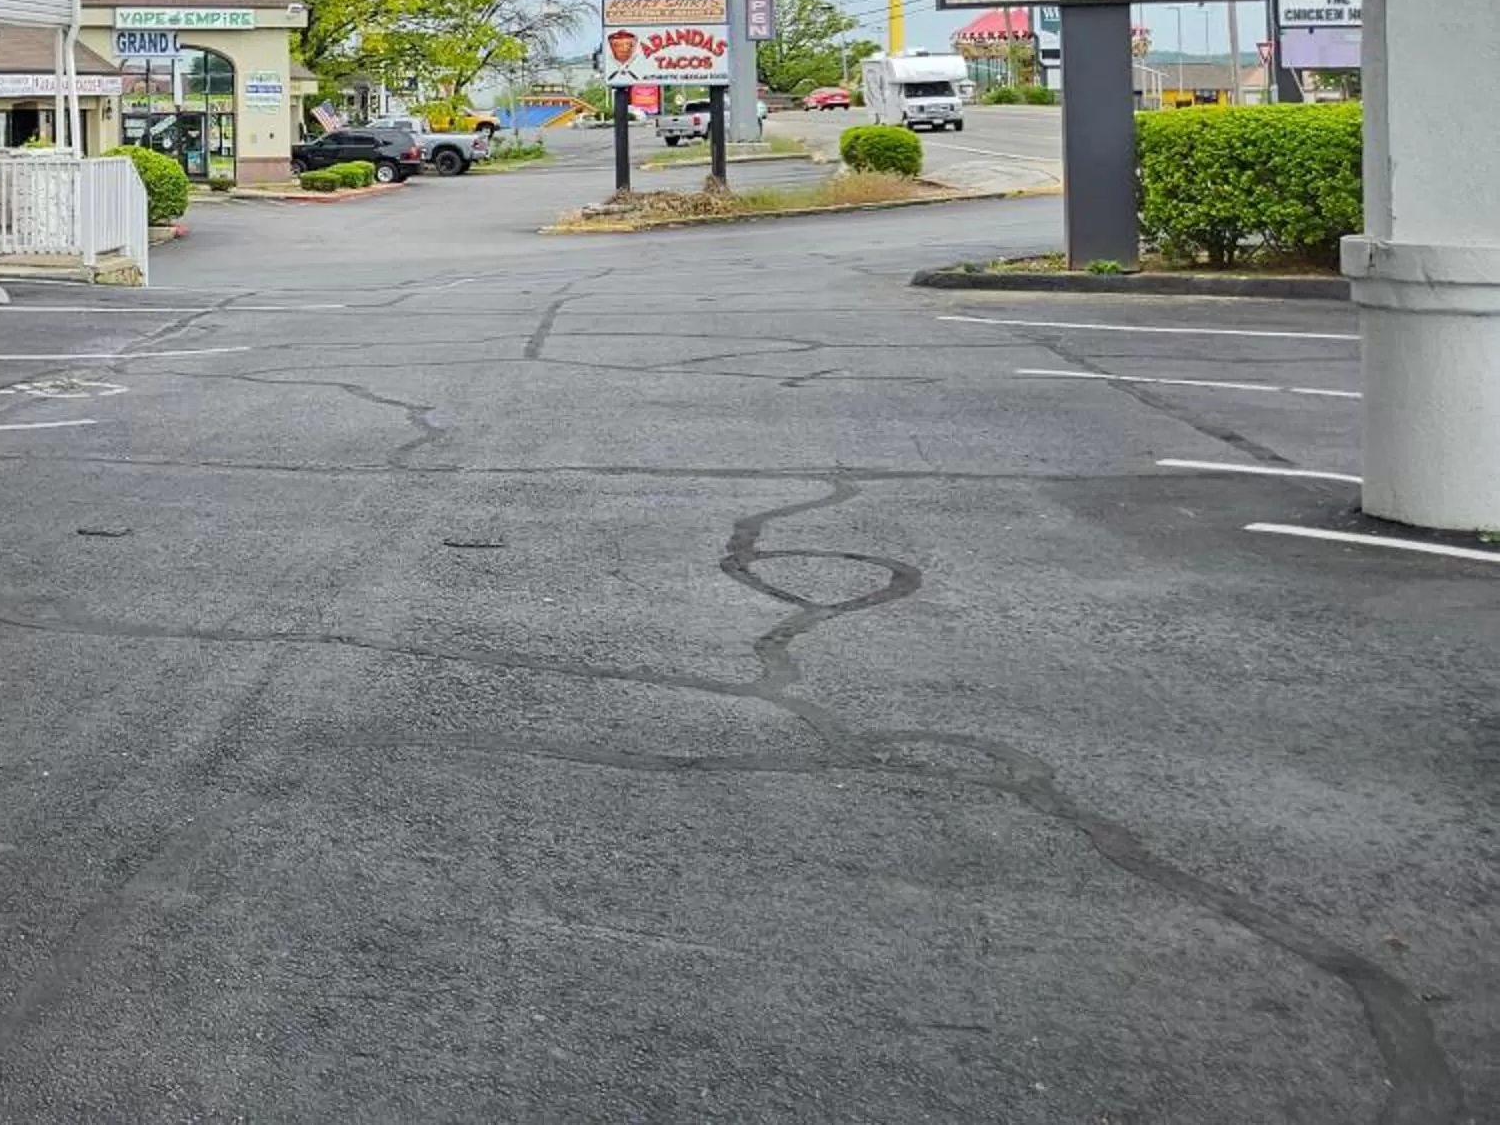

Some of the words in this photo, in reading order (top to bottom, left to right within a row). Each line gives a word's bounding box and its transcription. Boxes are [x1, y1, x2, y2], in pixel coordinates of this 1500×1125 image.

[120, 12, 165, 25] VAPE
[1284, 8, 1344, 21] CHICKEN
[117, 32, 169, 53] GRAND
[655, 56, 713, 69] TACOS
